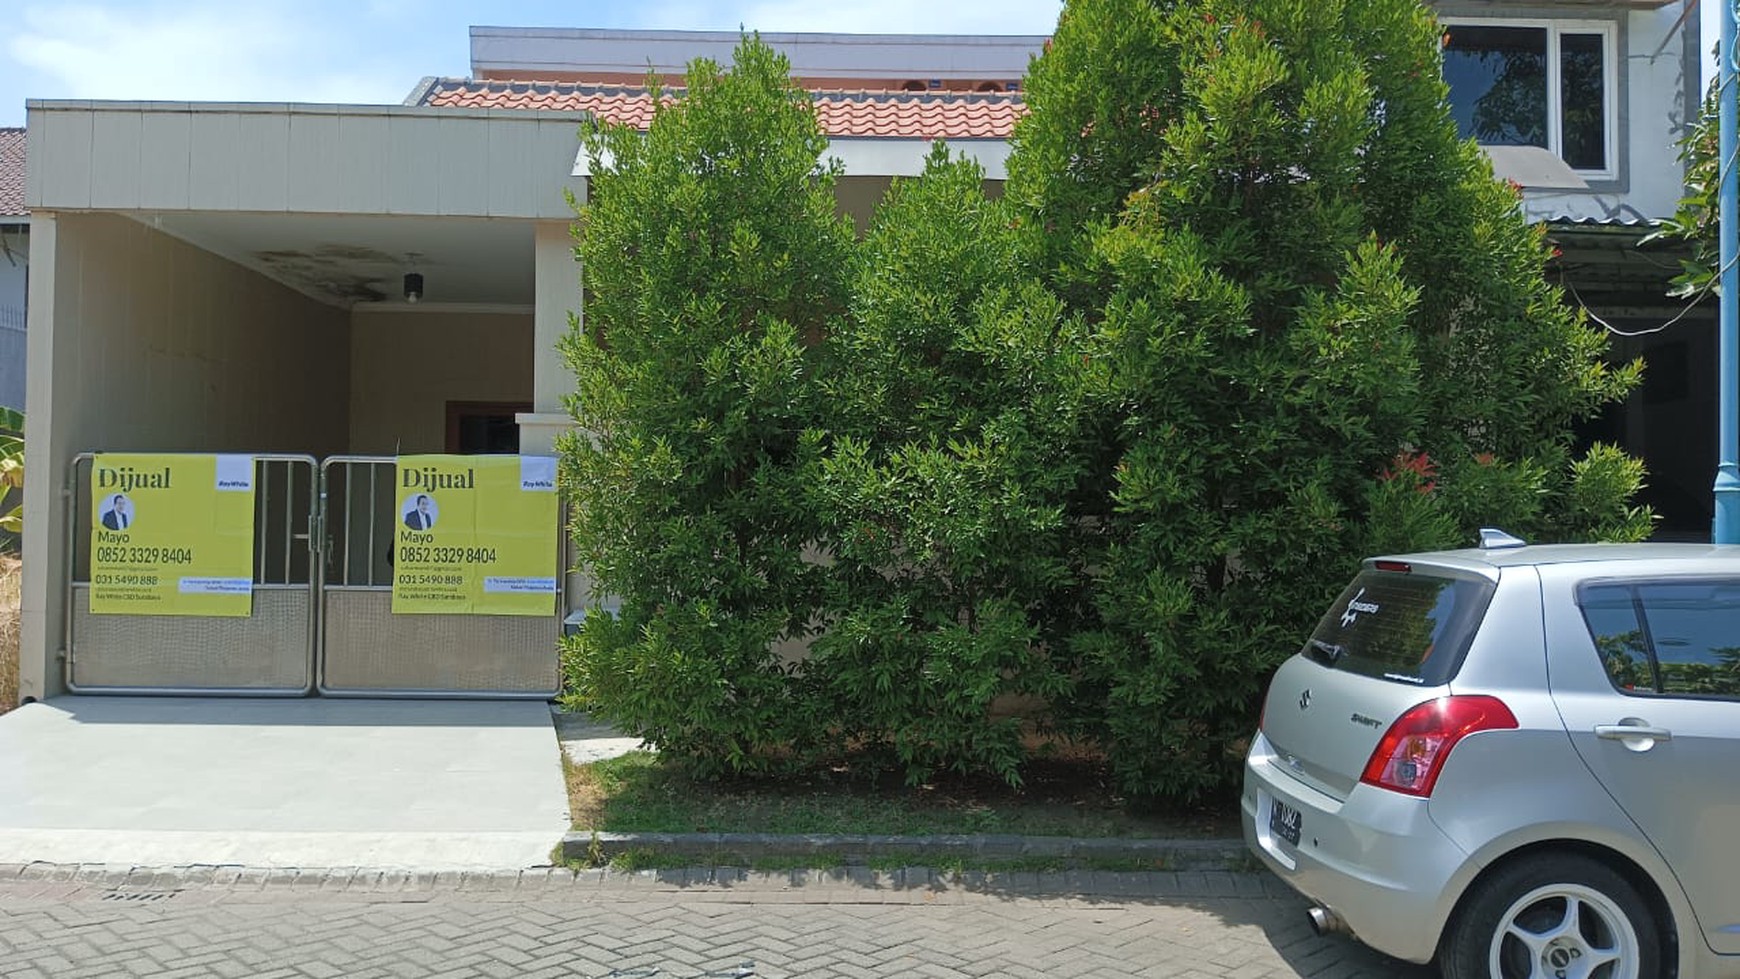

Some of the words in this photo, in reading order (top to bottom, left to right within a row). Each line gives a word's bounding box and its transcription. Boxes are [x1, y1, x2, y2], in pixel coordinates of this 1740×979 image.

[98, 467, 171, 493] Dijual
[402, 467, 475, 493] Dijual
[98, 530, 130, 545] Mayo
[400, 530, 434, 545] Mayo
[97, 547, 127, 563] 0852
[129, 547, 159, 564] 3329
[161, 548, 192, 565] 8404
[400, 546, 431, 563] 0852
[433, 547, 464, 563] 3329
[466, 548, 497, 564] 8404
[96, 574, 113, 584] 031
[115, 575, 139, 585] 5490
[140, 576, 158, 586] 888
[399, 574, 417, 584] 031
[419, 575, 444, 585] 5490
[445, 575, 463, 586] 888
